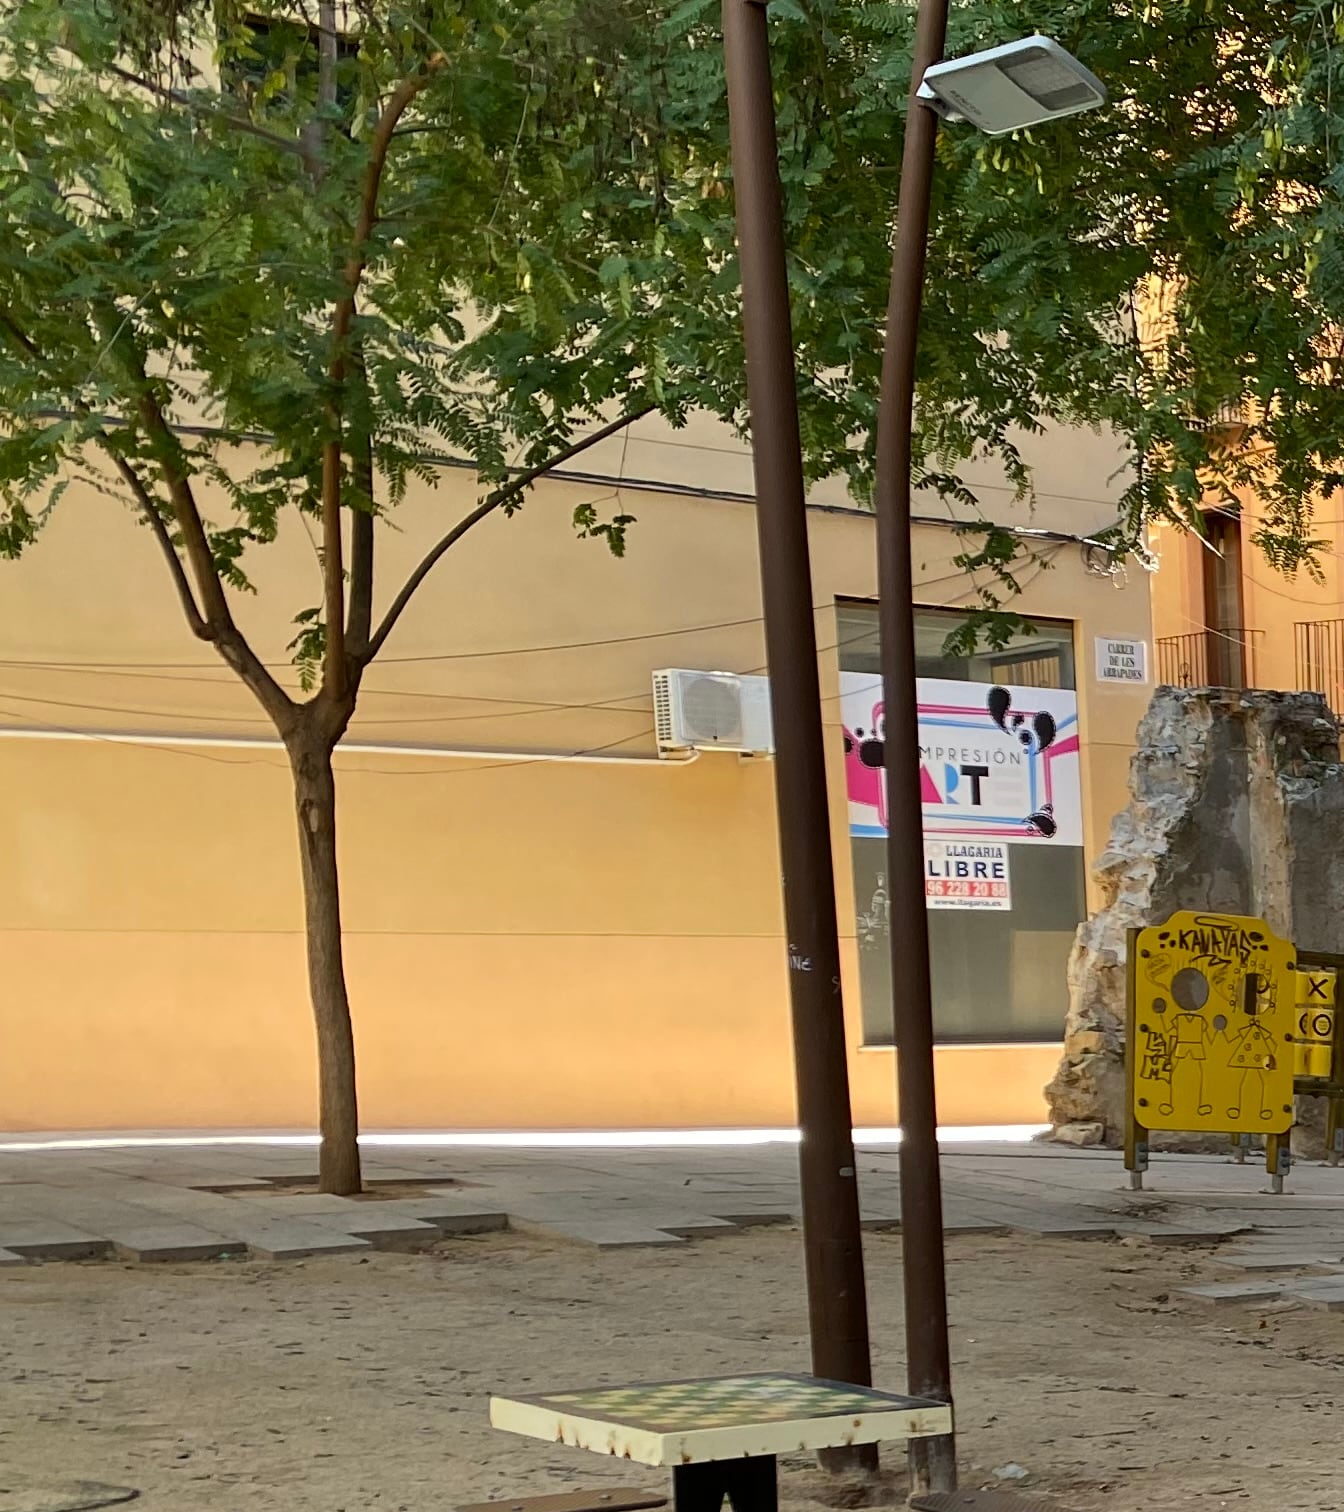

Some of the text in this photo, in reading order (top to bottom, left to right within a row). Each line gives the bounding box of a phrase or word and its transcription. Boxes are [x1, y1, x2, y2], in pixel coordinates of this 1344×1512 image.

[918, 745, 1021, 765] MPRESIÓN
[945, 845, 1003, 858] LLAGARIA
[928, 860, 1004, 879] LIBRE
